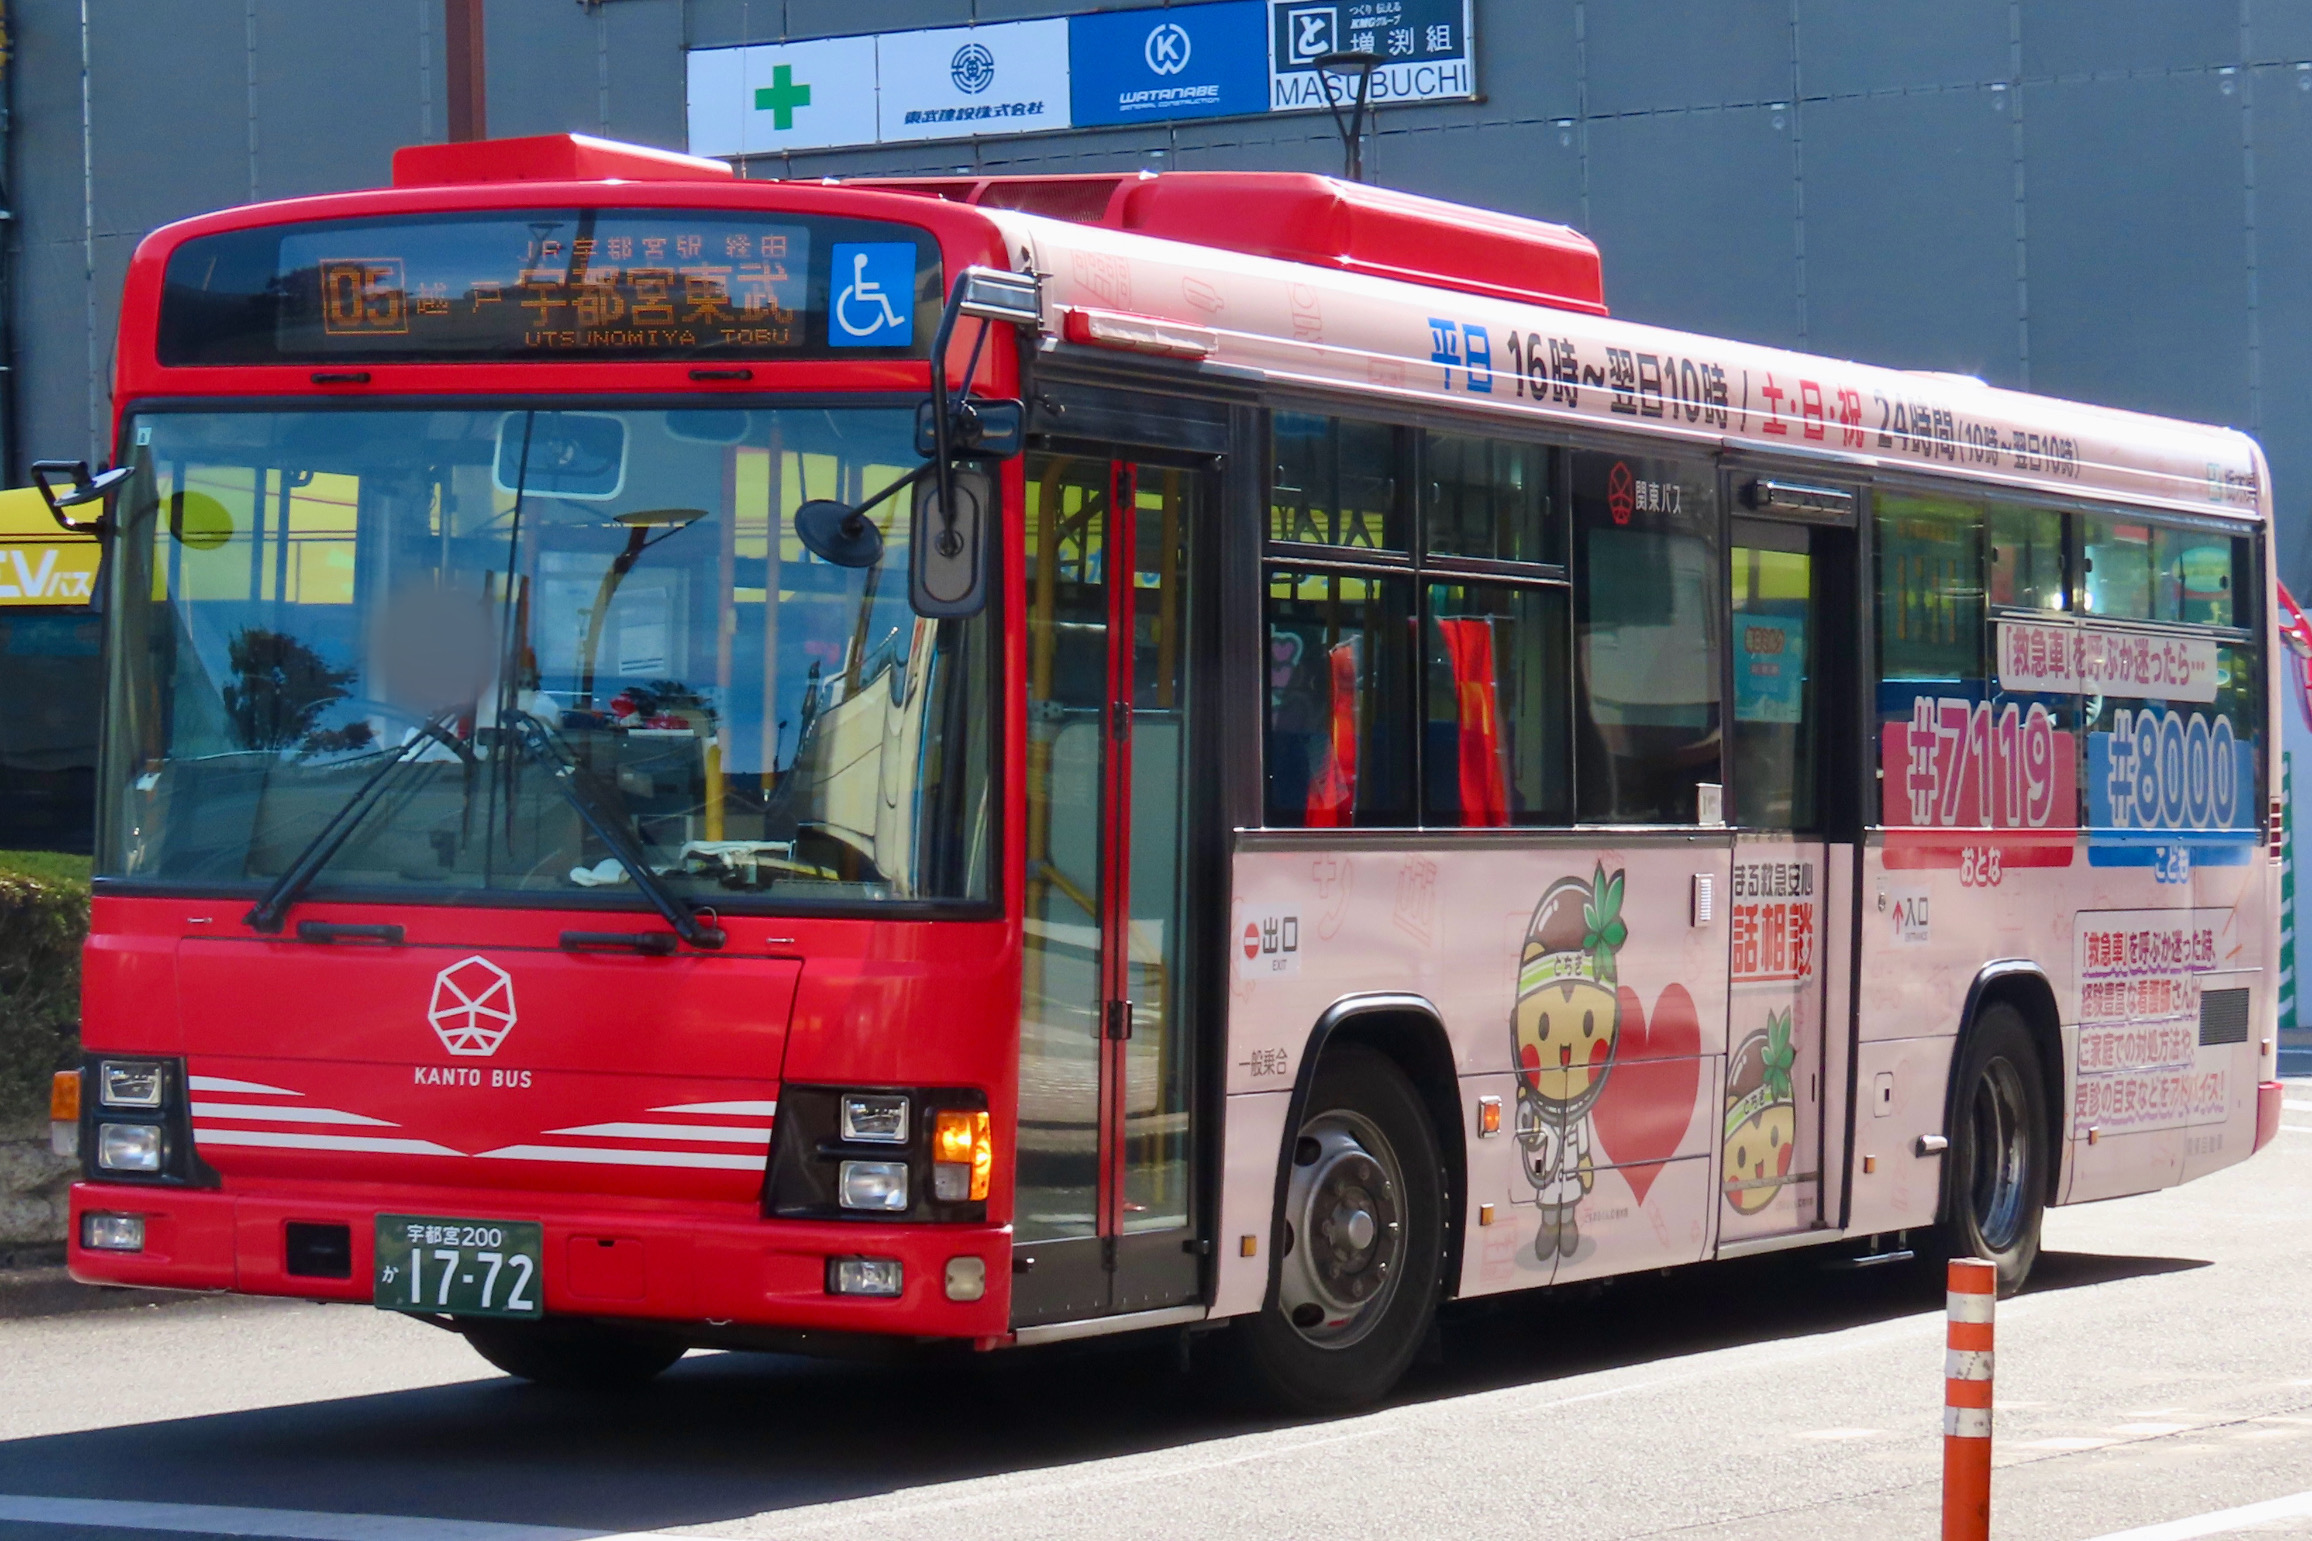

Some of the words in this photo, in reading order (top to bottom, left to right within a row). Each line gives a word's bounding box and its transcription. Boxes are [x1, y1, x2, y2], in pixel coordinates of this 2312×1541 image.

[1299, 16, 1329, 55] と
[1350, 25, 1452, 56] 増渕組
[1119, 85, 1219, 104] WATANABE
[329, 266, 401, 327] 05
[518, 262, 795, 326] 宇都宮東武
[525, 330, 696, 347] UTSUNOMIYA
[720, 328, 791, 344] TOBU
[1427, 316, 1494, 393] 平日
[1635, 480, 1682, 514] 関東バス
[1907, 696, 2055, 827] #7119
[2108, 709, 2237, 829] #8000
[1961, 847, 2001, 886] おとな
[2155, 847, 2190, 883] こども
[1905, 897, 1929, 927] 入口
[1263, 917, 1298, 954] 出口
[1272, 959, 1287, 971] EXIT
[1554, 955, 1582, 977] とちぎ
[415, 1066, 481, 1087] KANTO
[492, 1069, 532, 1089] BUS
[1239, 1048, 1288, 1077] 一般乗合
[406, 1224, 502, 1248] 宇都宮200
[381, 1265, 399, 1284] か
[411, 1248, 534, 1311] 17-72
